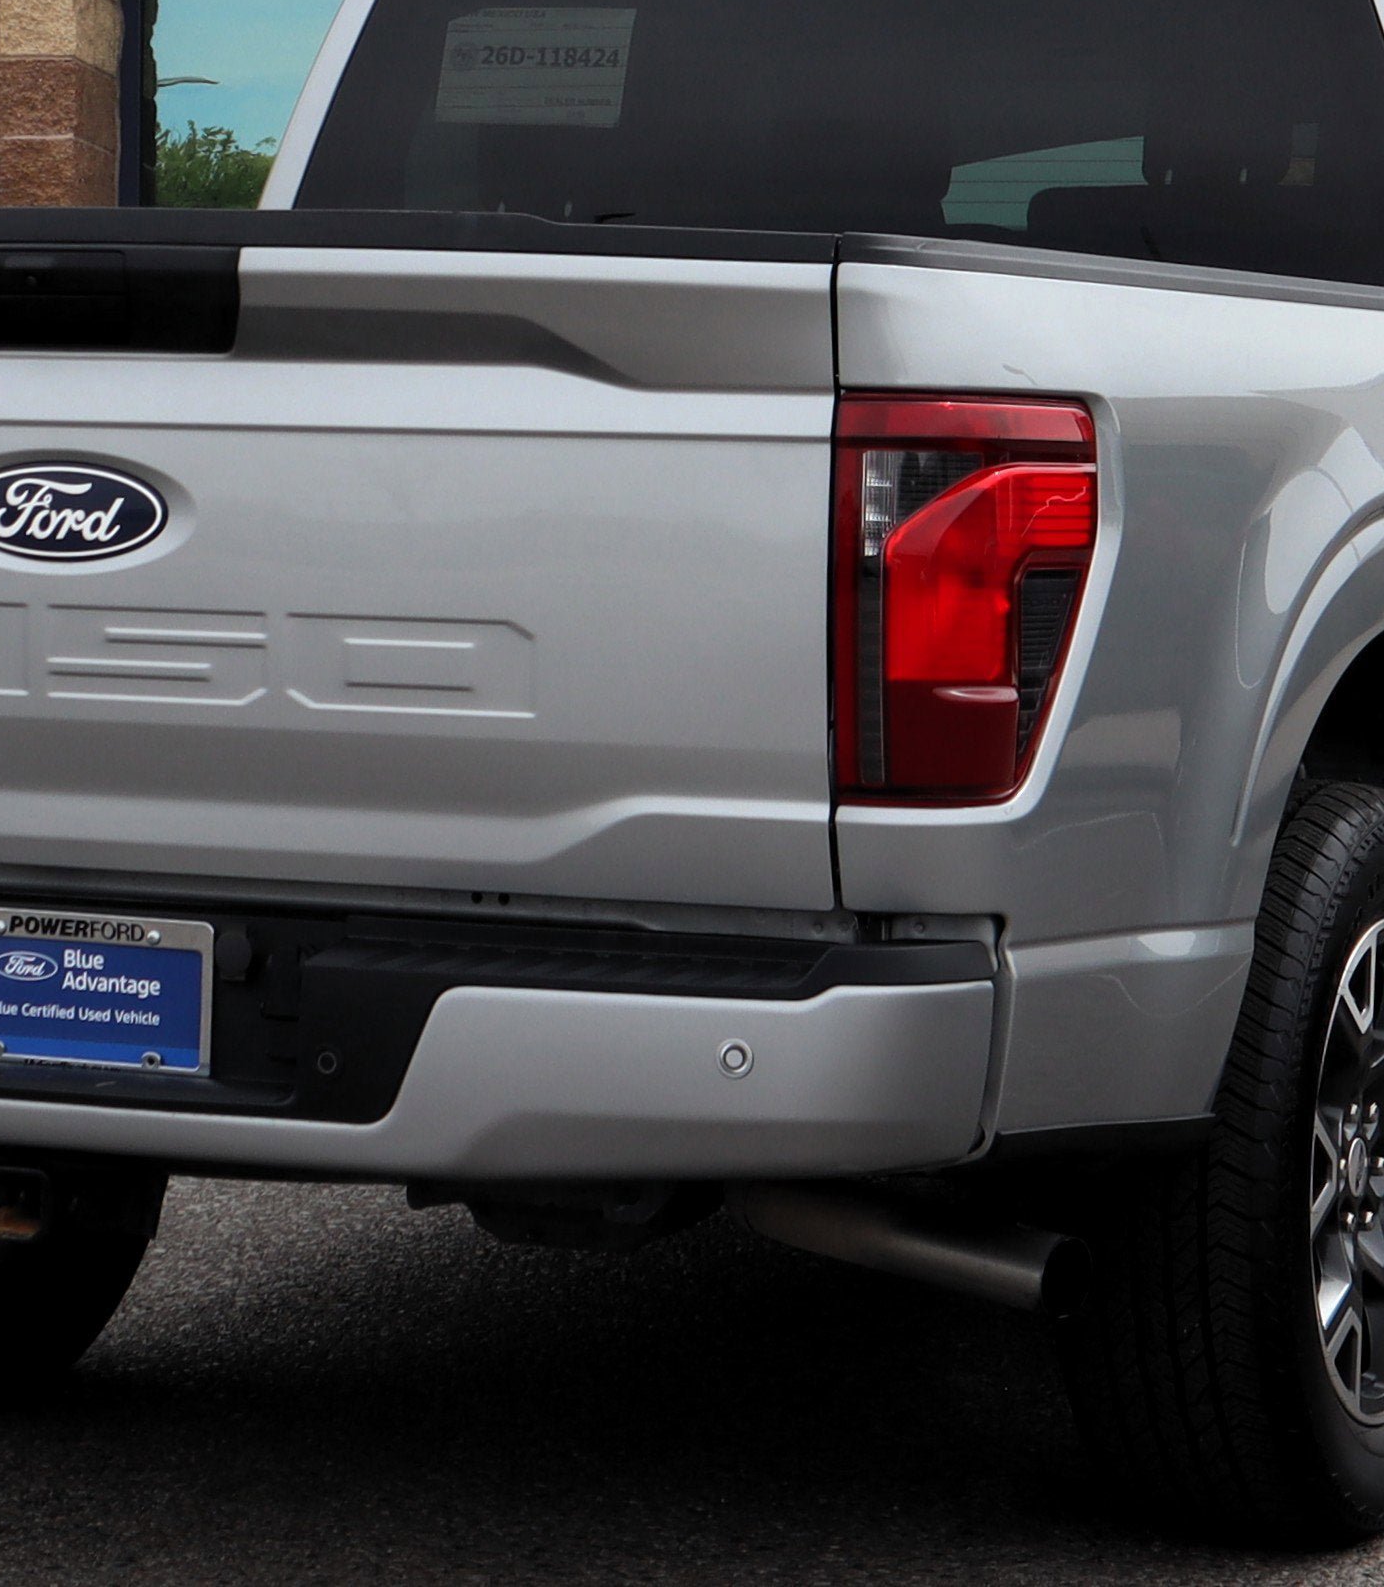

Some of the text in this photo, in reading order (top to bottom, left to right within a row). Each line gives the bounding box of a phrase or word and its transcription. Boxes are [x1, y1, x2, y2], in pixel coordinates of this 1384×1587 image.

[481, 45, 620, 68] 26D-118424
[9, 915, 145, 942] POWERFORD
[4, 954, 46, 977] Ford
[63, 949, 104, 970] Blue
[61, 971, 161, 998] Advantage
[21, 1002, 75, 1021] Certified
[78, 1005, 111, 1023] Used
[114, 1009, 160, 1026] Vehicle
